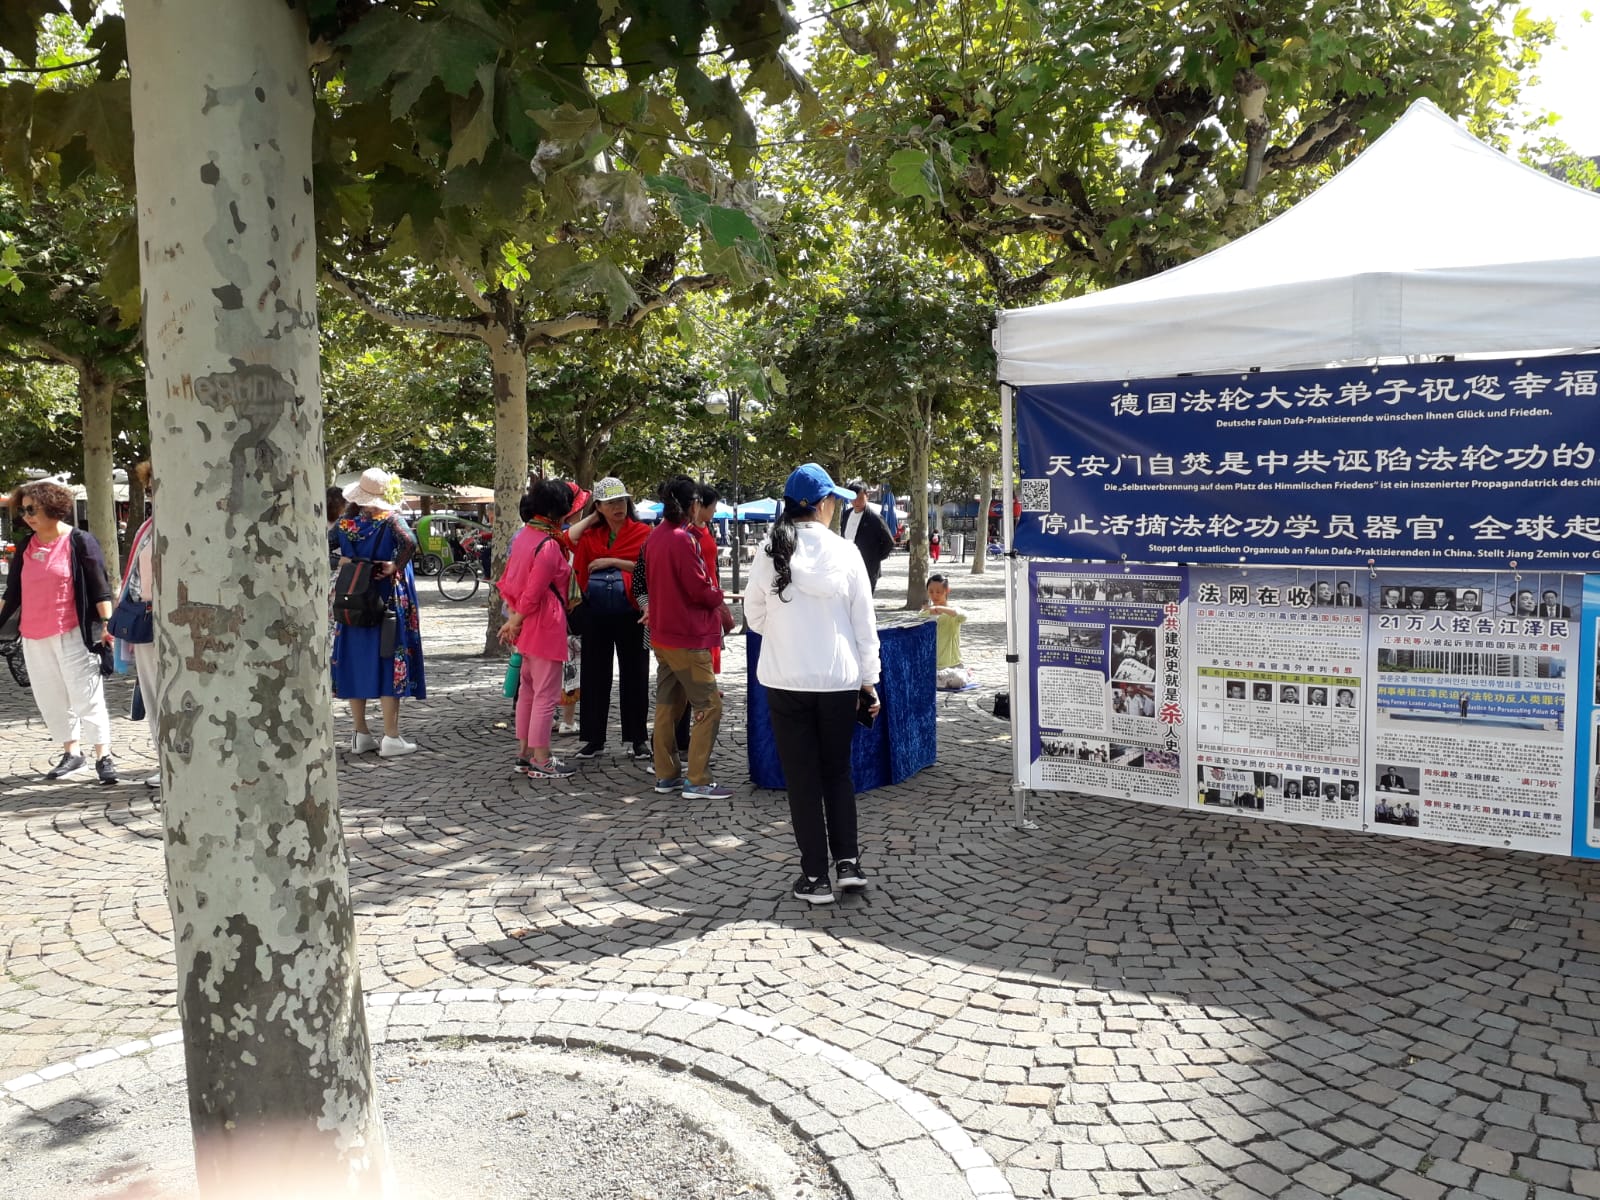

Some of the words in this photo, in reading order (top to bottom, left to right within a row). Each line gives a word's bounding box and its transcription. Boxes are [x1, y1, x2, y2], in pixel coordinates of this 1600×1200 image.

[1110, 369, 1599, 417] 德国法轮大法弟子祝您幸福
[1216, 419, 1256, 428] Deutsche
[1258, 417, 1282, 427] Falun
[1283, 413, 1374, 426] Dafa-Praktizierende
[1376, 412, 1424, 422] wünschen
[1426, 411, 1454, 420] Ihnen
[1456, 409, 1485, 419] Glück
[1487, 409, 1508, 418] und
[1510, 407, 1553, 417] Frieden.
[1046, 441, 1595, 477] 天安门自焚是中共诬陷法轮功的
[1104, 483, 1117, 491] Die
[1199, 482, 1213, 491] auf
[1215, 482, 1233, 491] dem
[1235, 481, 1256, 491] Platz
[1257, 481, 1273, 490] des
[1274, 480, 1332, 490] Himmlischen
[1380, 480, 1392, 489] ist
[1393, 480, 1409, 489] ein
[1411, 479, 1469, 489] inszenierter
[1471, 478, 1558, 490] Propagandatrick
[1560, 478, 1579, 487] des
[1148, 543, 1176, 554] Stoppt
[1178, 544, 1193, 553] den
[1195, 544, 1241, 554] staatlichen
[1243, 545, 1290, 556] Organraub
[1304, 546, 1329, 555] Falun
[1331, 547, 1430, 557] Dafa-Praktizierenden
[1432, 548, 1442, 557] in
[1444, 548, 1476, 557] China.
[1478, 548, 1504, 558] Stellt
[1506, 548, 1534, 560] Jiang
[1536, 549, 1570, 559] Zemin
[1571, 551, 1590, 559] vor
[1200, 585, 1310, 606] 法网在收
[1161, 603, 1182, 753] 中共建政史就是杀人史
